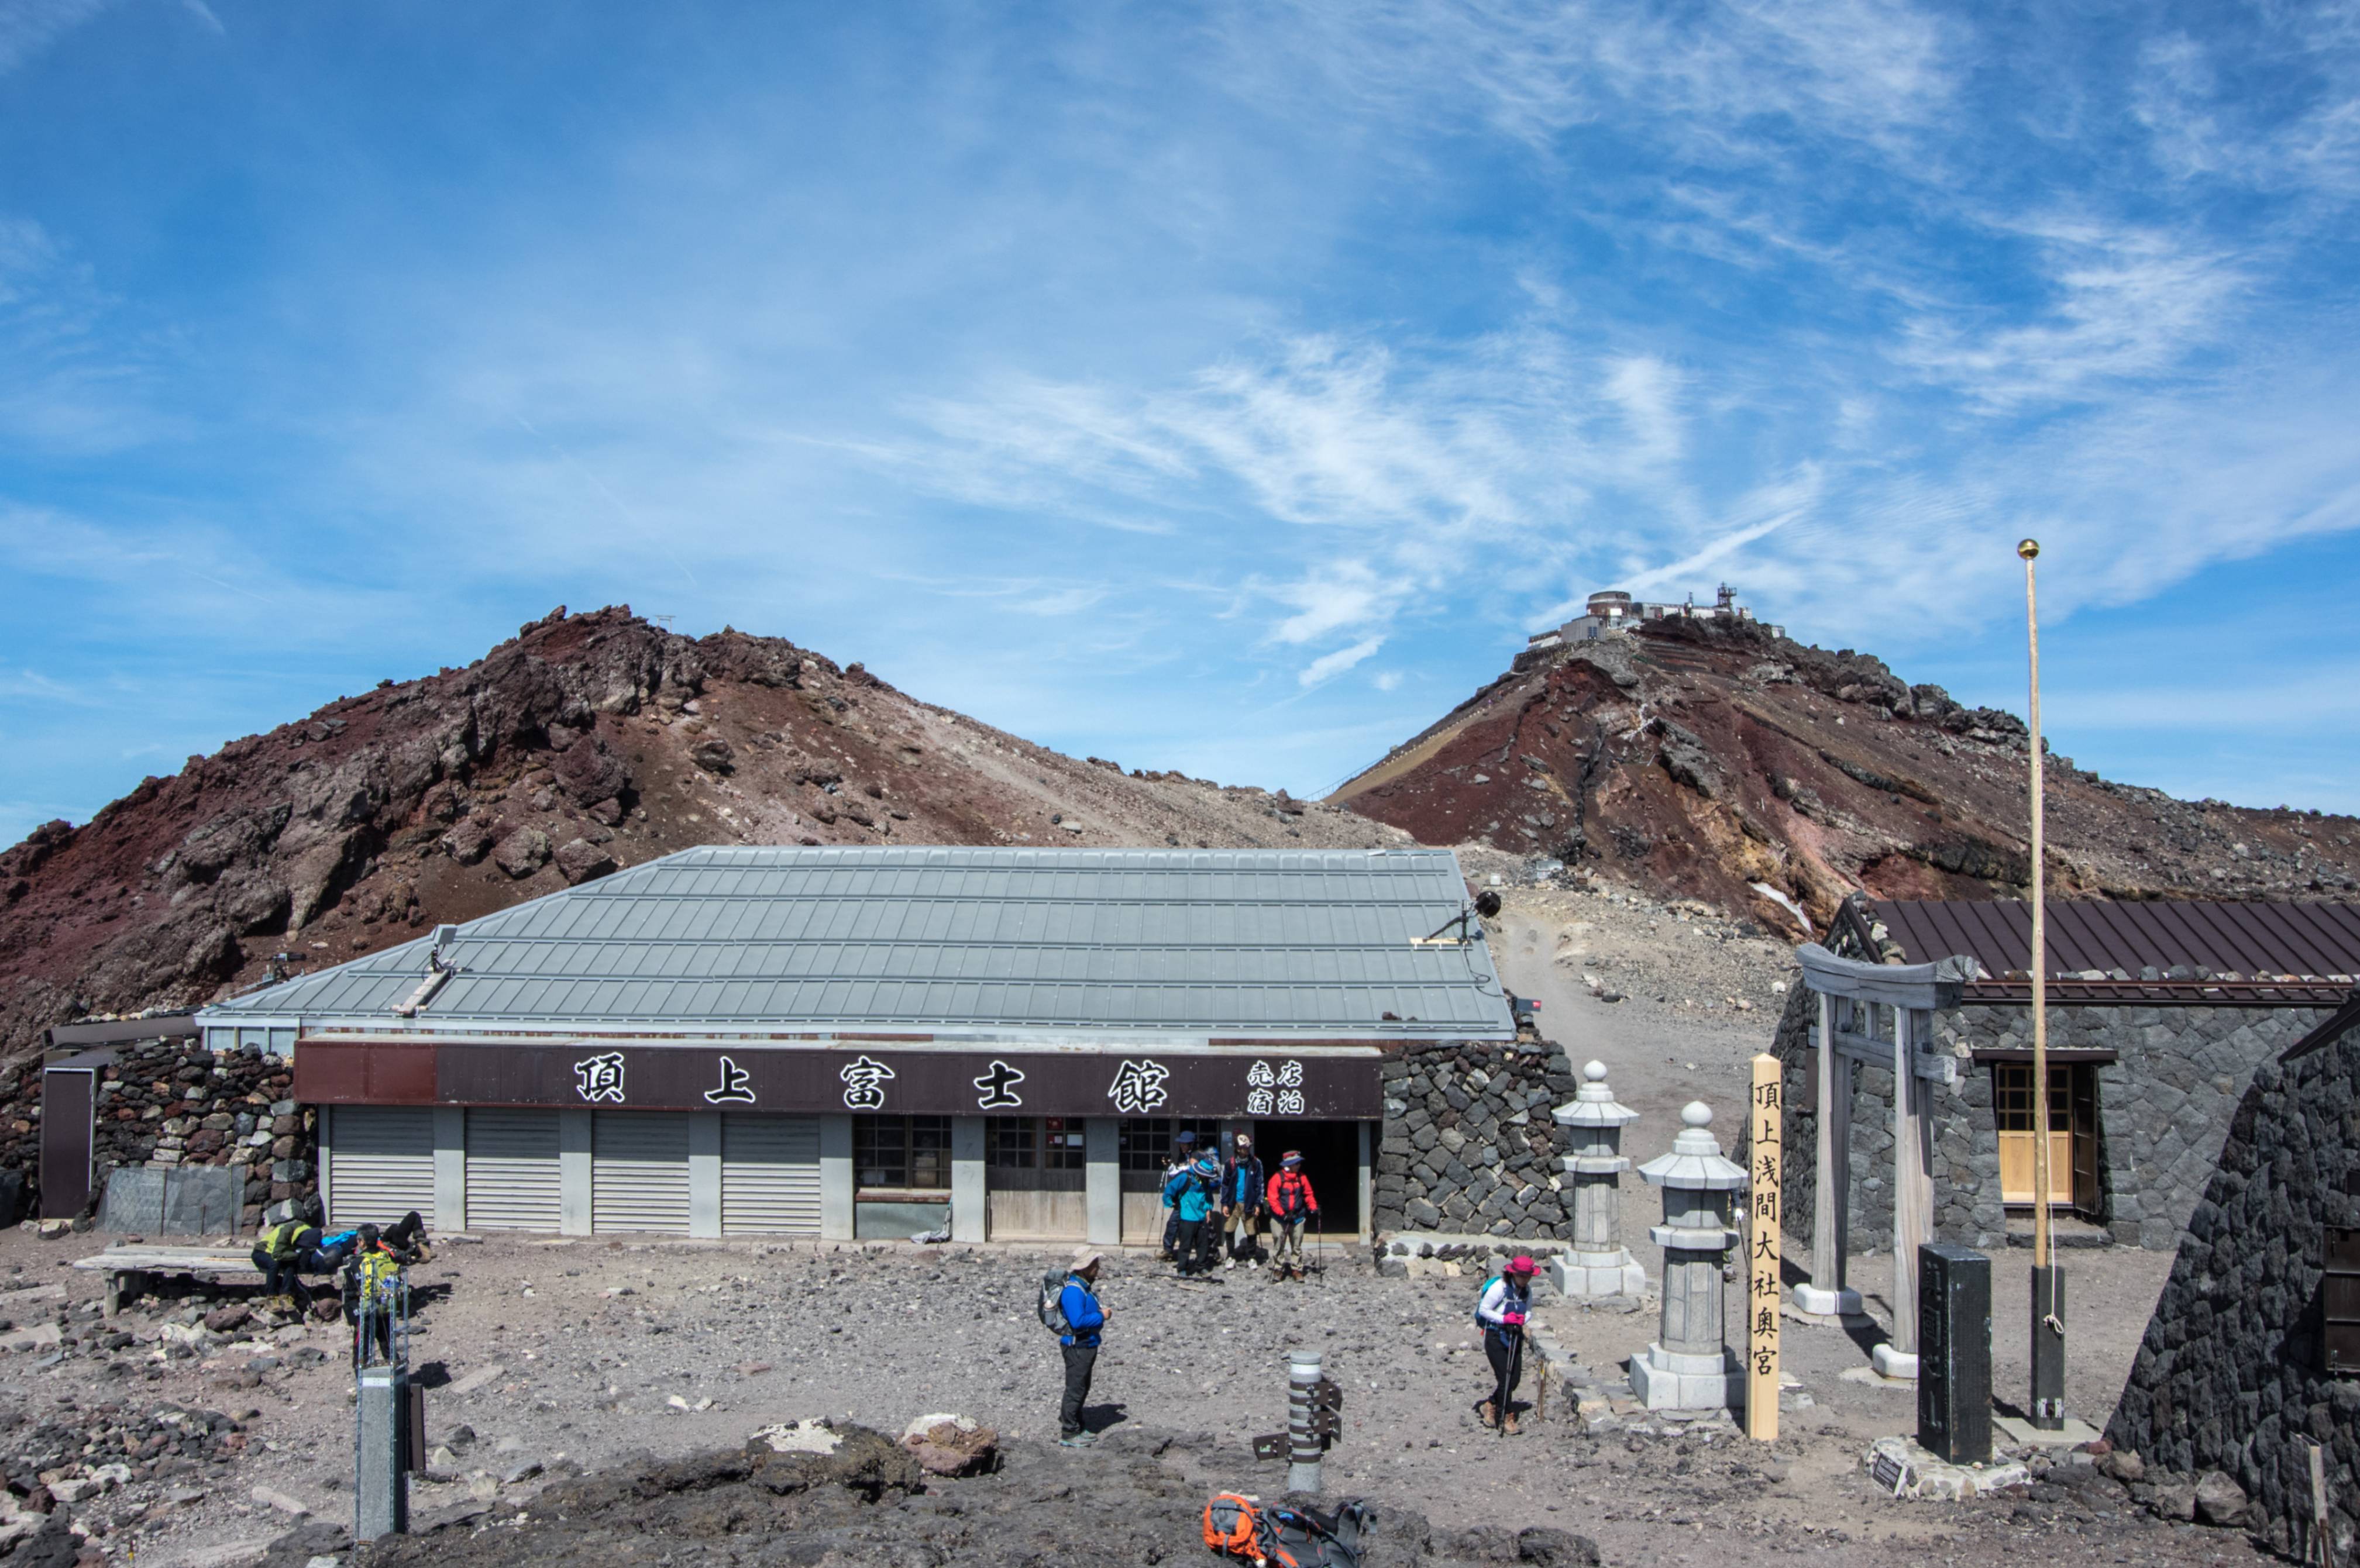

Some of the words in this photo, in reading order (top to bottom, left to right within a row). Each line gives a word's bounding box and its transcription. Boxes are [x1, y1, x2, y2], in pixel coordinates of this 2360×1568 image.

[574, 1052, 1169, 1112] 頂上富士館
[1247, 1059, 1303, 1087] 売店
[1247, 1088, 1305, 1115] 宿泊
[1753, 1081, 1780, 1376] 頂上浅間大社奥宮
